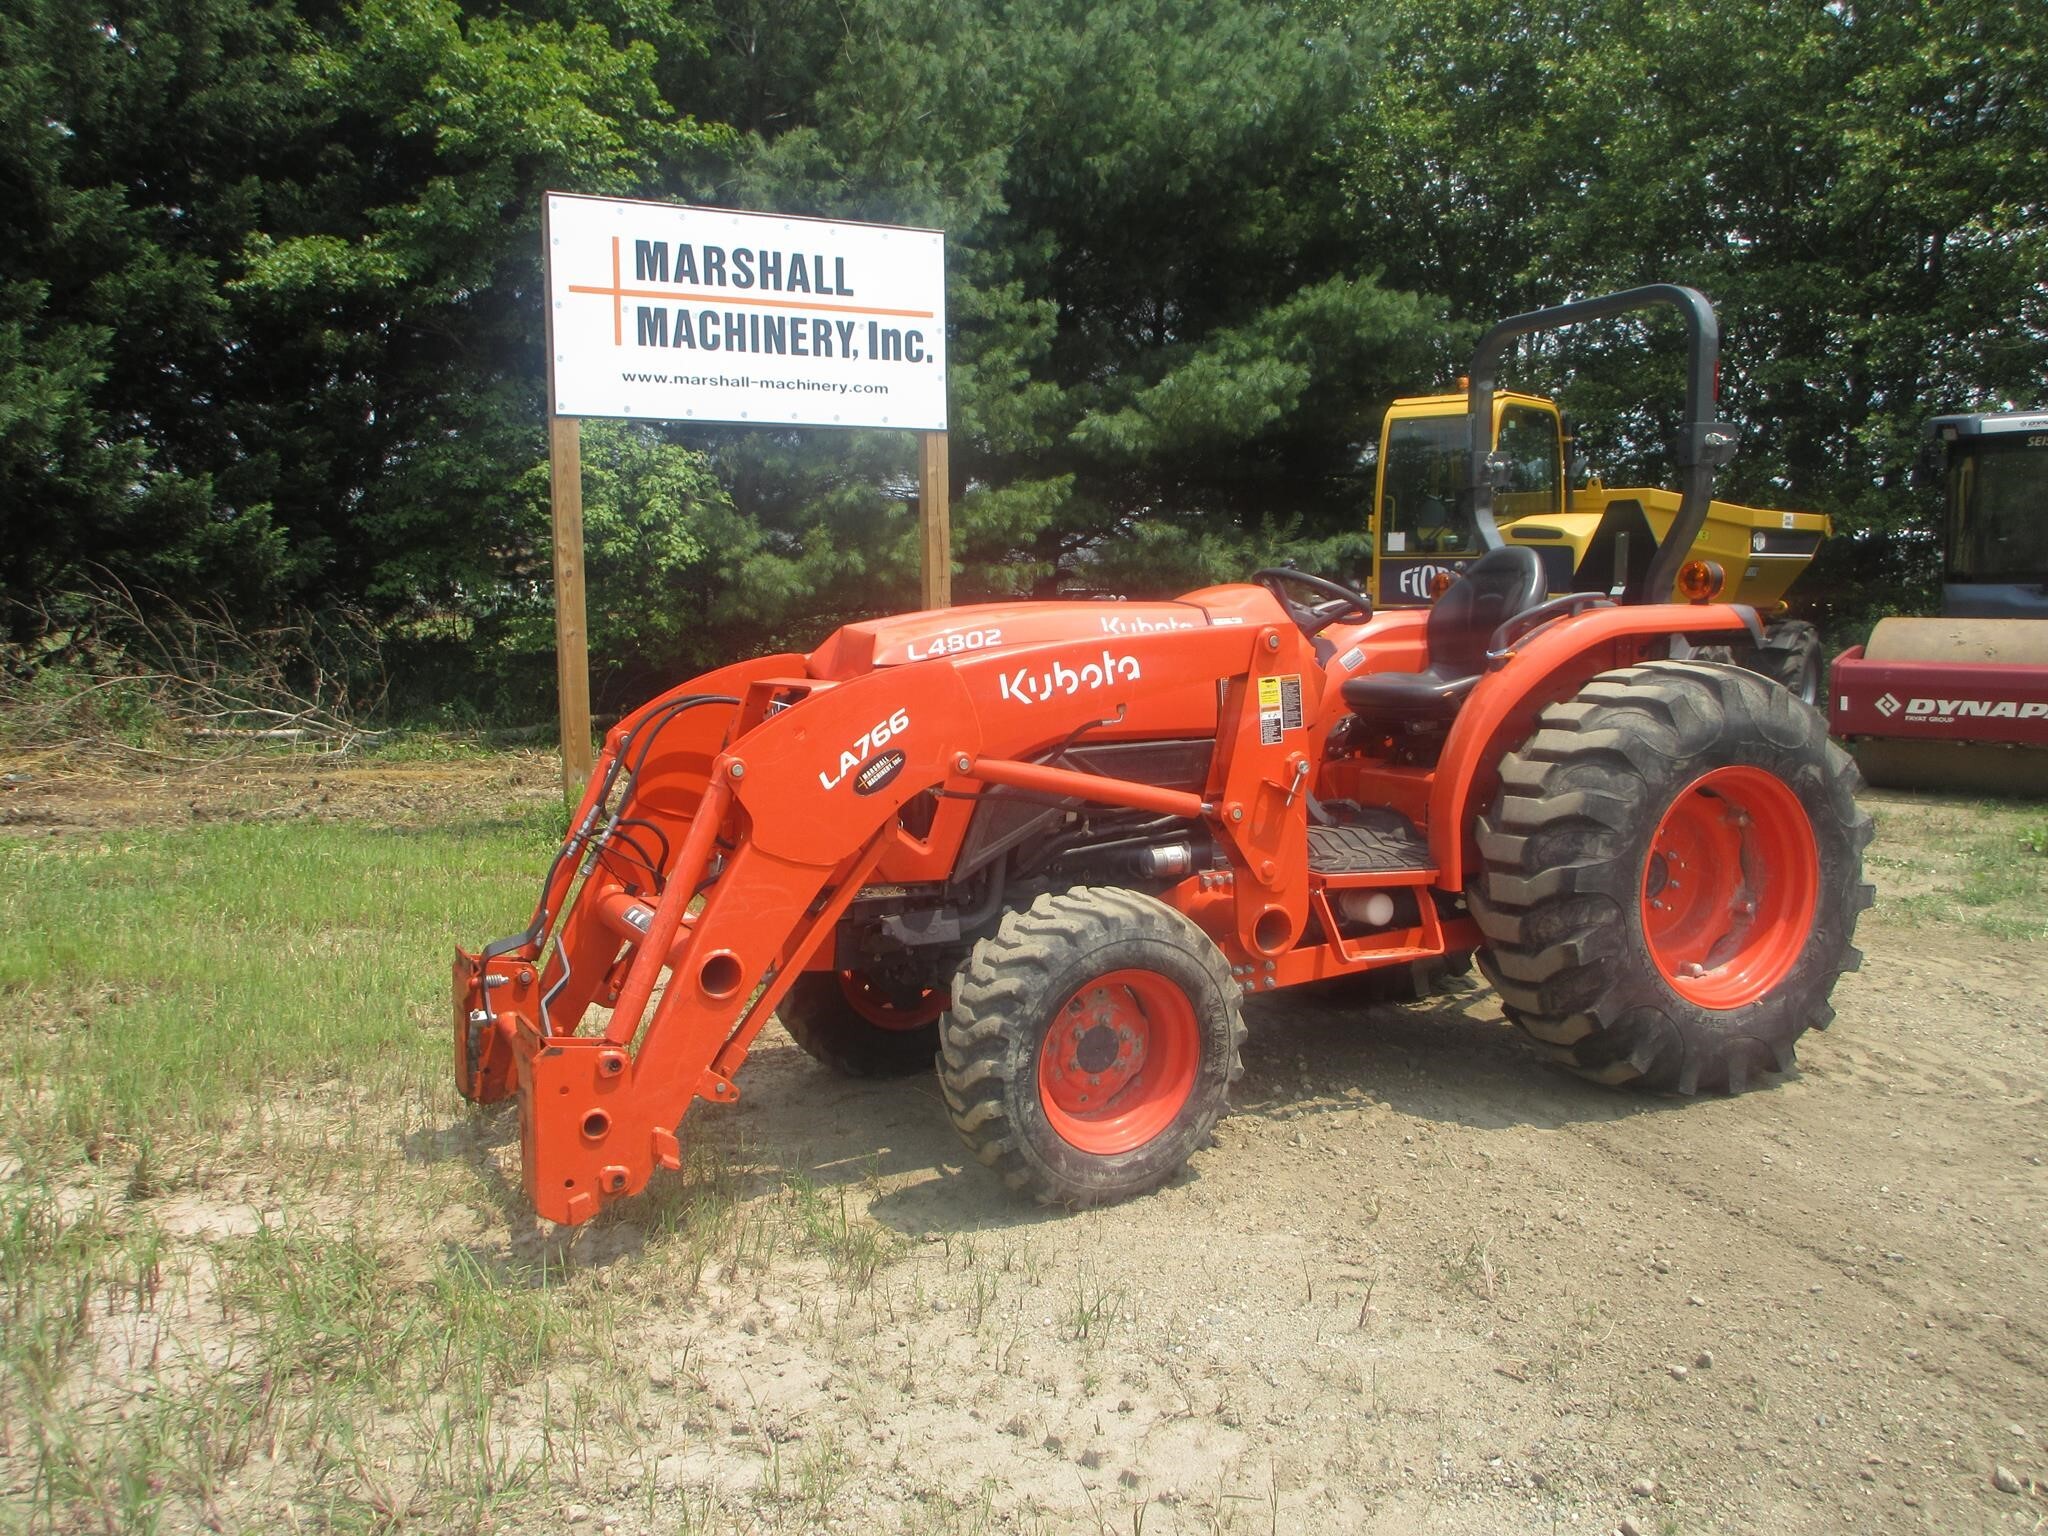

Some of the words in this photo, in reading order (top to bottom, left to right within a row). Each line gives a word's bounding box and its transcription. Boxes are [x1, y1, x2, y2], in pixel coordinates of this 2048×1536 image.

[635, 239, 855, 297] MARSHALL
[637, 306, 860, 362] MACHINERY,
[868, 320, 934, 364] Inc.
[621, 371, 889, 395] www.marshall-machinery.com
[906, 628, 1002, 662] L4802
[1000, 650, 1140, 704] Kubota
[1905, 698, 2048, 719] DYNAP
[818, 707, 911, 790] LA766
[862, 756, 890, 780] MARSHALL
